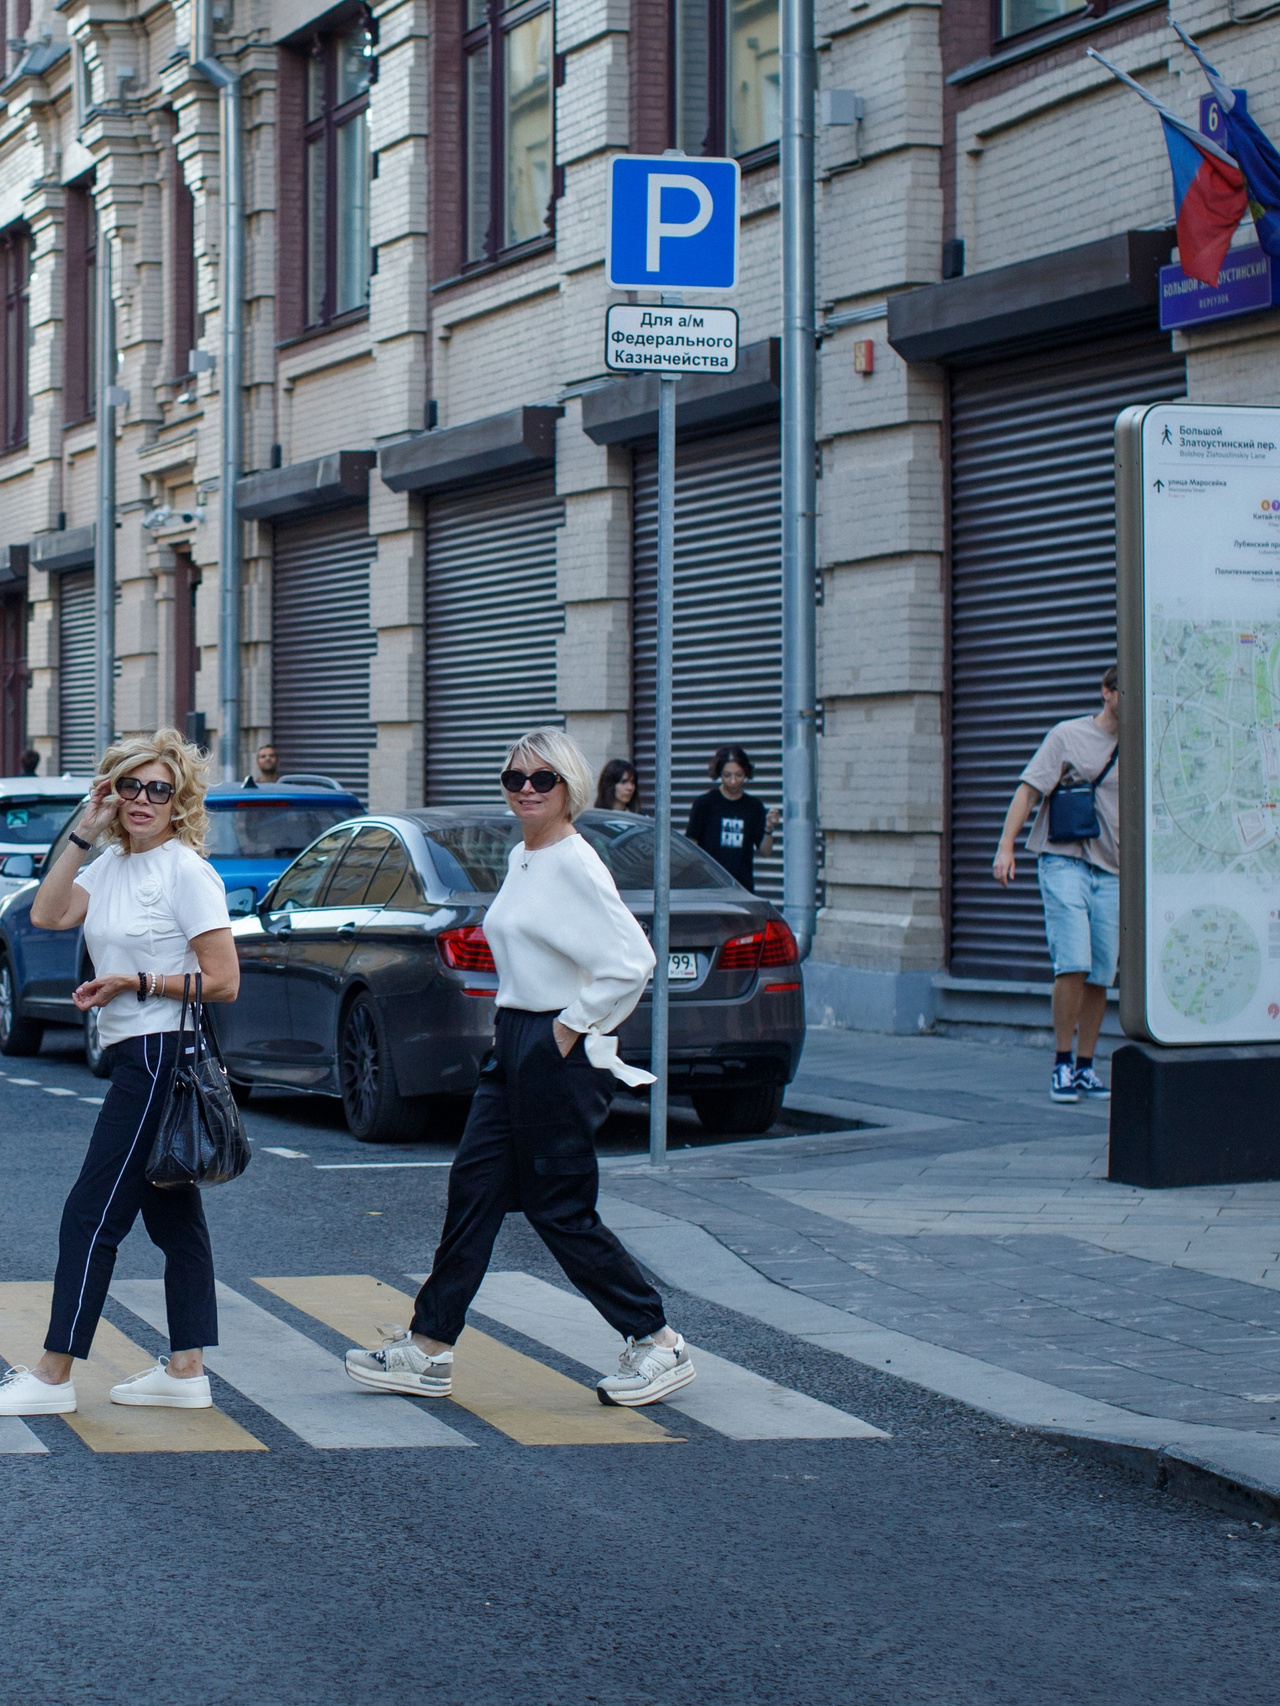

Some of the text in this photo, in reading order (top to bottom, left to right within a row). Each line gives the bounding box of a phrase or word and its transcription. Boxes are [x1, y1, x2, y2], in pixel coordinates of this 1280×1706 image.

[1208, 102, 1219, 132] 6
[646, 173, 714, 272] P
[1200, 257, 1267, 291] ЗОУСТИНСКИЙ
[1198, 293, 1229, 309] ПЕРЕУЛОК
[640, 312, 704, 328] Для а/м
[611, 330, 733, 349] Федерального
[614, 350, 729, 367] Казначейства
[1179, 425, 1223, 436] Большой
[1179, 437, 1277, 451] Златоустинский пер.
[668, 955, 690, 970] 99
